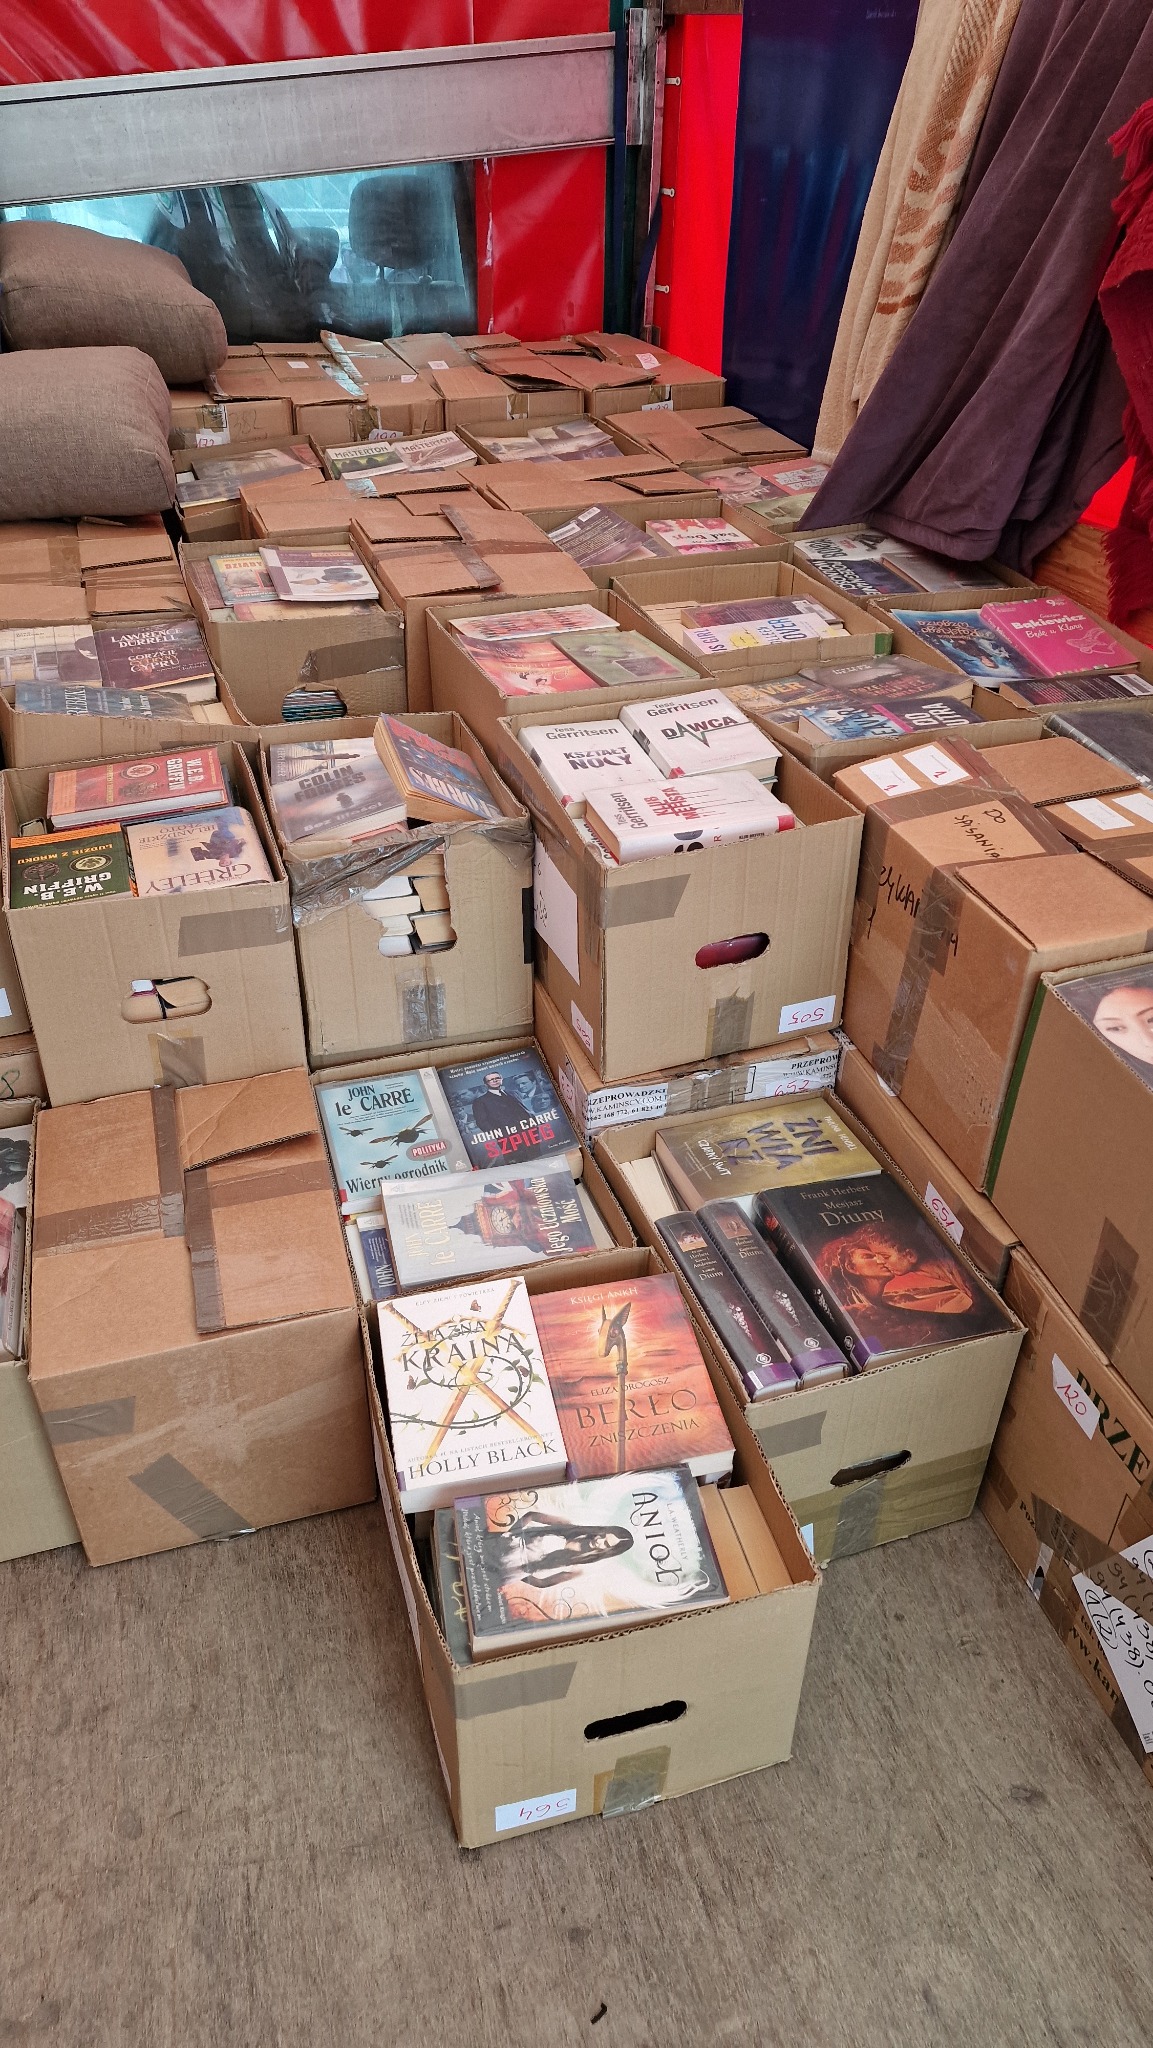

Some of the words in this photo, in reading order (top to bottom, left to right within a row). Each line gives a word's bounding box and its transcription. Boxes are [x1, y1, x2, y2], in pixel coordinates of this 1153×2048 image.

[334, 446, 388, 458] MASTERTON
[402, 436, 454, 452] MASTERTON
[1011, 614, 1086, 630] Bąkiewicz
[1059, 623, 1083, 632] Klary
[111, 628, 183, 643] LAWRENCE
[118, 635, 179, 648] DURRELL
[647, 698, 718, 717] Gerritsen
[546, 727, 619, 740] Gerritsen
[661, 716, 738, 742] DAWCA
[563, 747, 627, 759] KSZTAŁT
[568, 754, 633, 770] NOCY
[166, 757, 186, 790] GRIFFIN
[298, 765, 354, 790] COLIN
[294, 772, 366, 801] FORBES
[610, 793, 648, 829] Gerritsen
[644, 796, 669, 817] KLUB
[661, 787, 698, 820] MEFISTA
[617, 814, 626, 825] Tess
[983, 808, 1006, 825] DO
[17, 854, 58, 865] MROKU
[72, 843, 113, 856] LUDZIE
[23, 872, 112, 895] GRIFFIN
[146, 864, 252, 894] GREELEY
[34, 882, 104, 901] W.E.B.
[348, 1085, 376, 1101] JOHN
[335, 1102, 352, 1116] le
[471, 1128, 497, 1145] JOHN
[506, 1124, 518, 1134] le
[484, 1124, 555, 1159] SZPIEG
[783, 1118, 839, 1155] ŻNI
[412, 1142, 446, 1157] POLITYKA
[799, 1189, 831, 1201] Frank
[832, 1183, 870, 1198] Herbert
[531, 1177, 554, 1228] Uczniowska
[824, 1199, 864, 1211] Mesjasz
[819, 1208, 885, 1228] Diuny
[546, 1229, 569, 1254] Jego
[431, 1251, 456, 1266] le
[739, 1250, 764, 1258] Diuny
[375, 1264, 397, 1288] JOHN
[699, 1272, 724, 1280] Diuny
[570, 1293, 605, 1306] KSIĘGI
[607, 1287, 638, 1299] ANKH
[401, 1321, 486, 1347] ŻELAZNA
[401, 1332, 525, 1372] KRAINA
[590, 1386, 618, 1397] ELIZA
[623, 1377, 671, 1391] DROGOSZ
[575, 1389, 697, 1430] BERŁO
[1057, 1384, 1087, 1416] 120
[588, 1418, 700, 1447] ZNISZCZENIA
[408, 1453, 480, 1479] HOLLY
[487, 1439, 557, 1465] BLACK
[630, 1492, 683, 1586] ANIOŁ
[669, 1516, 689, 1561] WEATHERLY
